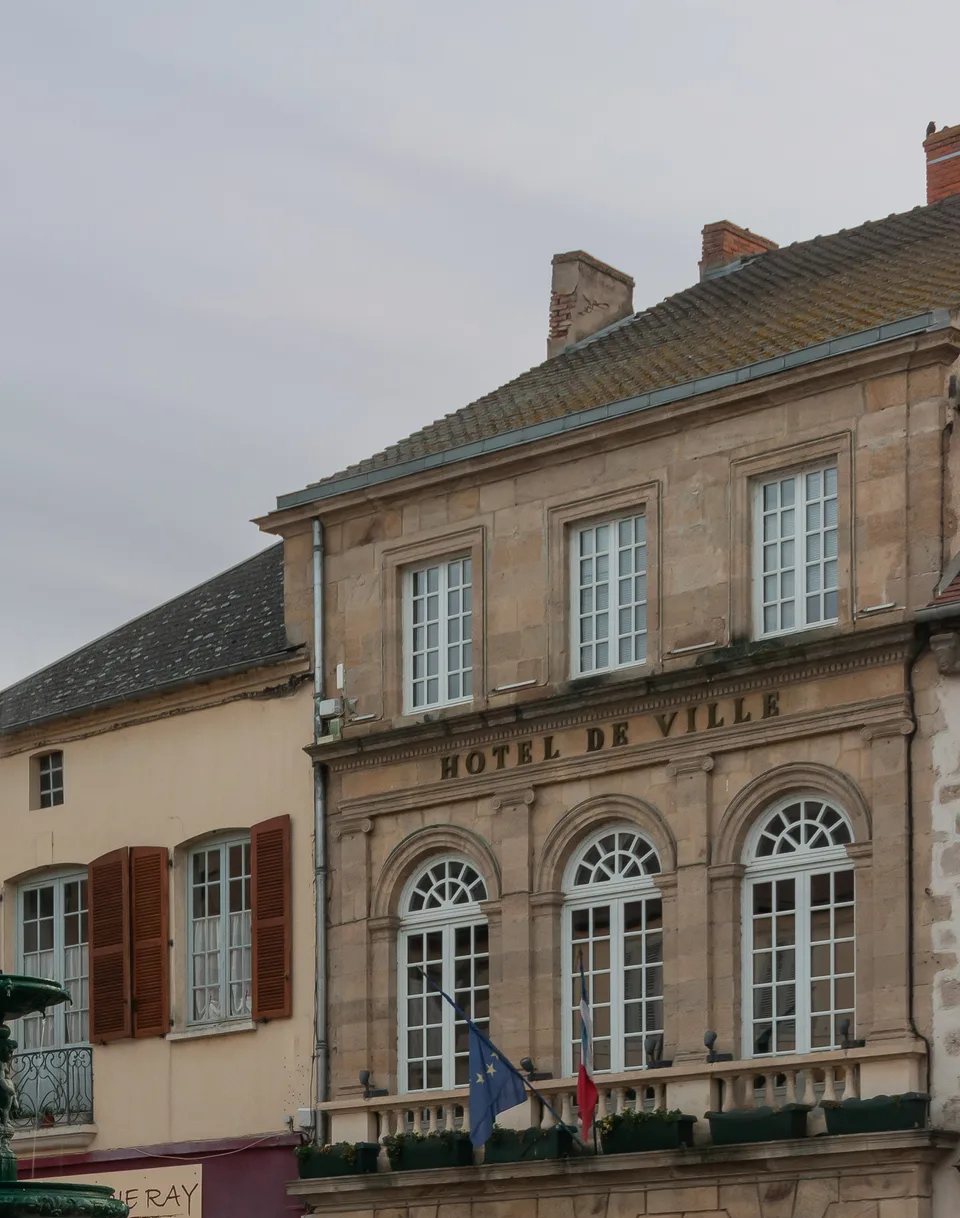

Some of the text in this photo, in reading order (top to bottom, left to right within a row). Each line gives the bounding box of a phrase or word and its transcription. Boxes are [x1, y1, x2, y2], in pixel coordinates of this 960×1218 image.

[440, 691, 780, 780] HOTEL DE VILLE
[144, 1183, 199, 1216] RAY
